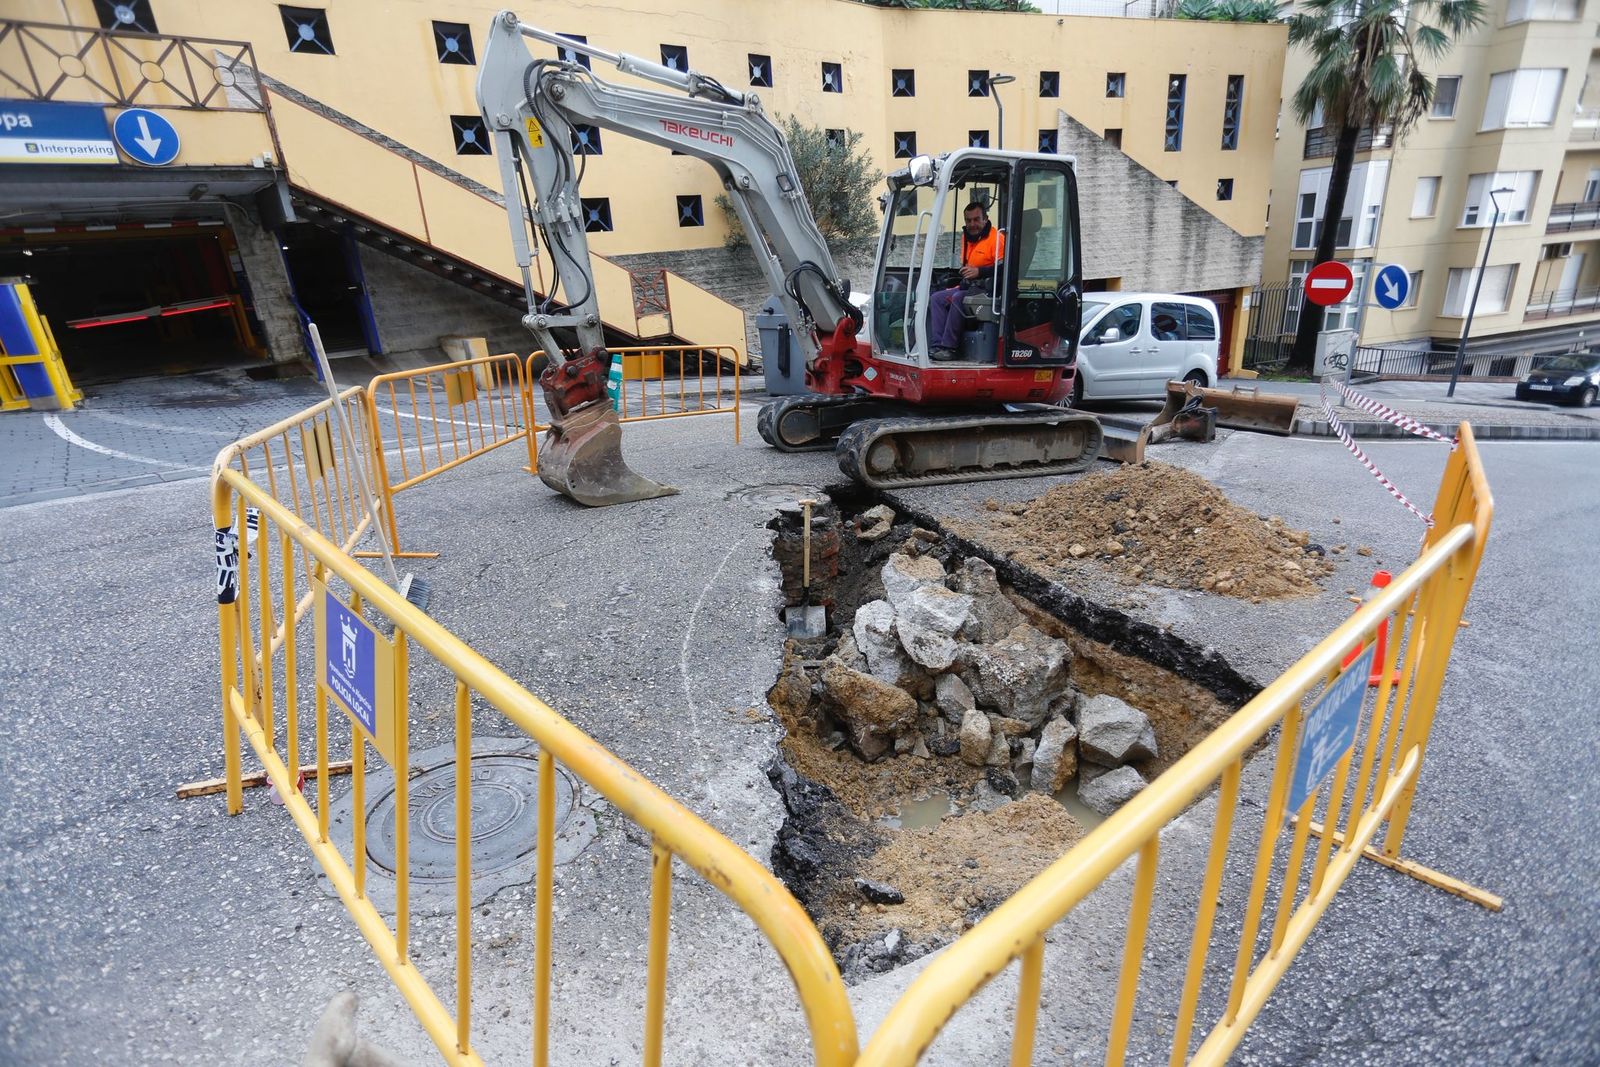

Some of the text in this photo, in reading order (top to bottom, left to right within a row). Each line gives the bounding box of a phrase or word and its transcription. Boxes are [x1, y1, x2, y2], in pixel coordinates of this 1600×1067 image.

[41, 144, 113, 156] Interparking
[1011, 350, 1033, 358] TB260
[352, 697, 371, 727] LOCAL
